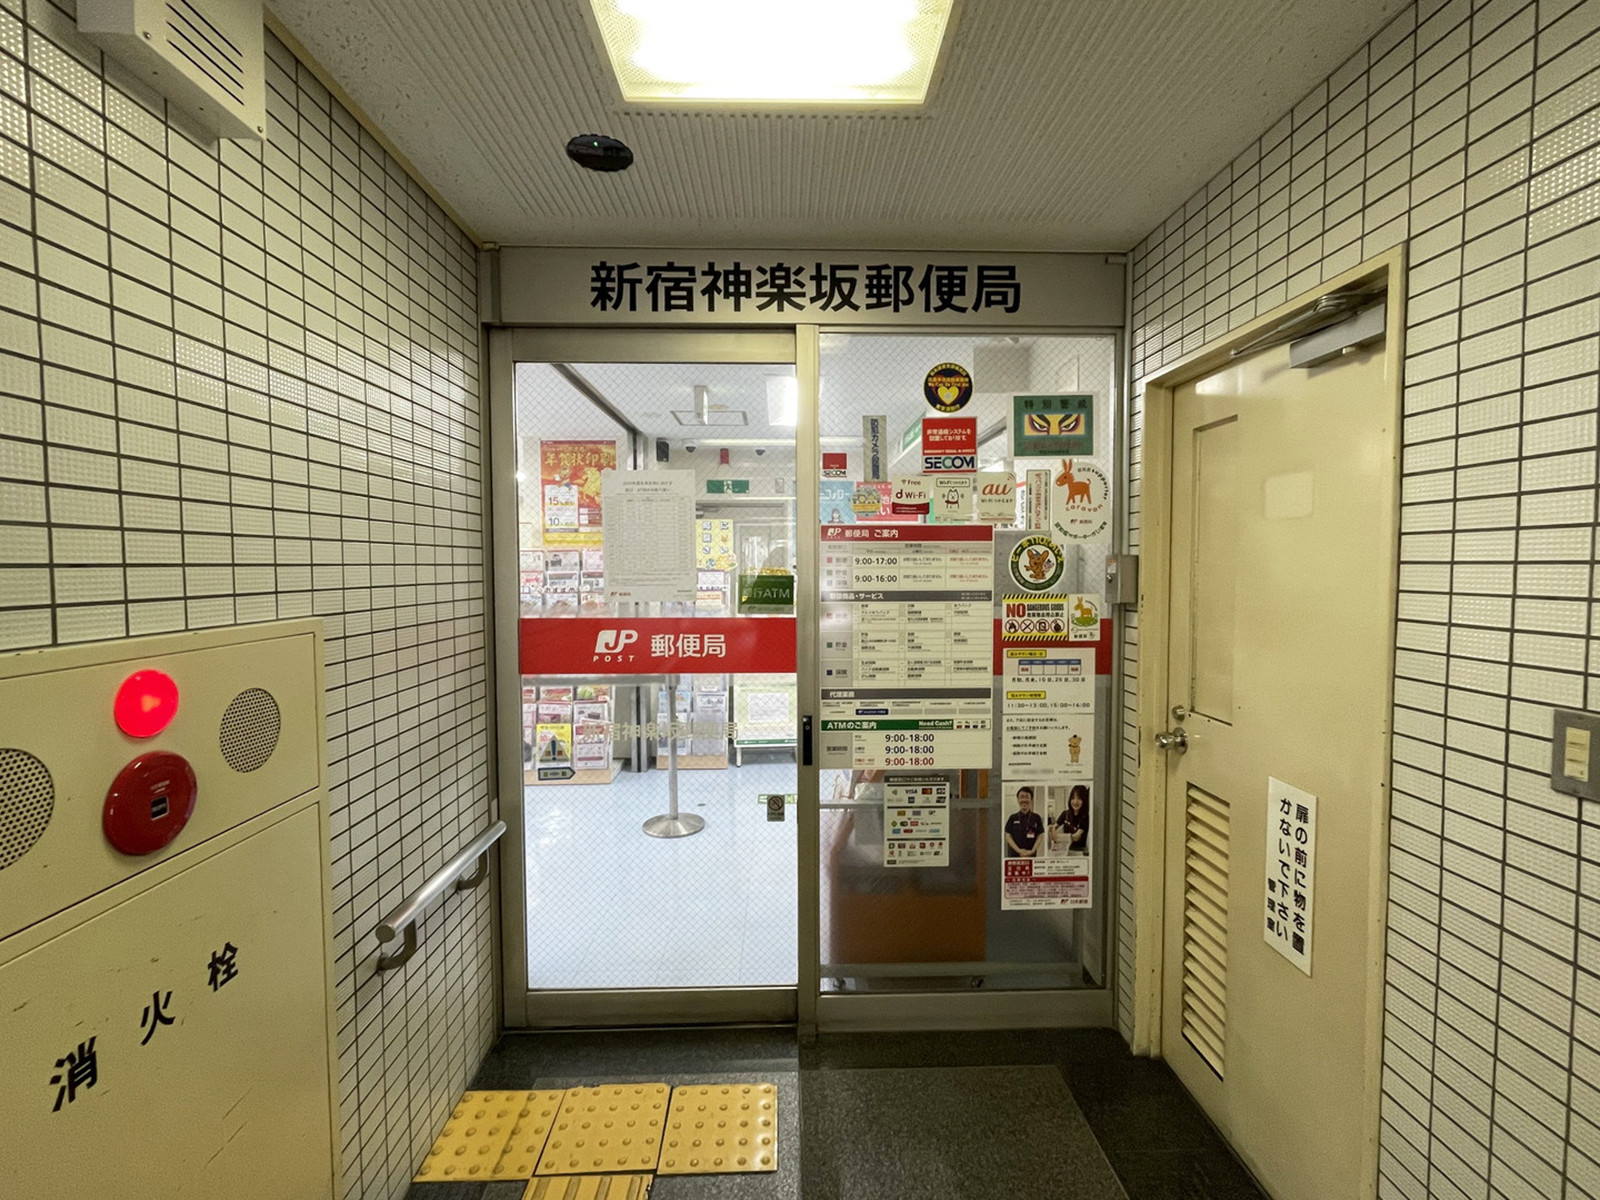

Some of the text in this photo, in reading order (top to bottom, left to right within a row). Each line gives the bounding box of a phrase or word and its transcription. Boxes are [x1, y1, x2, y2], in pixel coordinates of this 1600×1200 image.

[590, 261, 1021, 314] 新宿神楽坂郵便局
[925, 456, 975, 469] SECOM
[895, 489, 926, 499] d Wi-Fi
[982, 483, 1012, 495] au
[1065, 504, 1103, 512] caravan
[844, 529, 870, 537] 郵便局
[874, 529, 899, 538] ご案内
[855, 557, 898, 565] 9:00-17:00
[855, 575, 898, 583] 9:00-16:00
[1006, 603, 1027, 618] NO
[594, 629, 726, 658] JP 郵便局
[826, 721, 877, 730] ATMのご案内
[884, 733, 935, 743] 9:00-18:00
[884, 745, 935, 754] 9:00-18:00
[884, 757, 935, 766] 9:00-18:00
[1276, 797, 1292, 941] かないで下さい
[1291, 803, 1309, 956] 扉の前に物を置
[49, 941, 238, 1113] 消火栓
